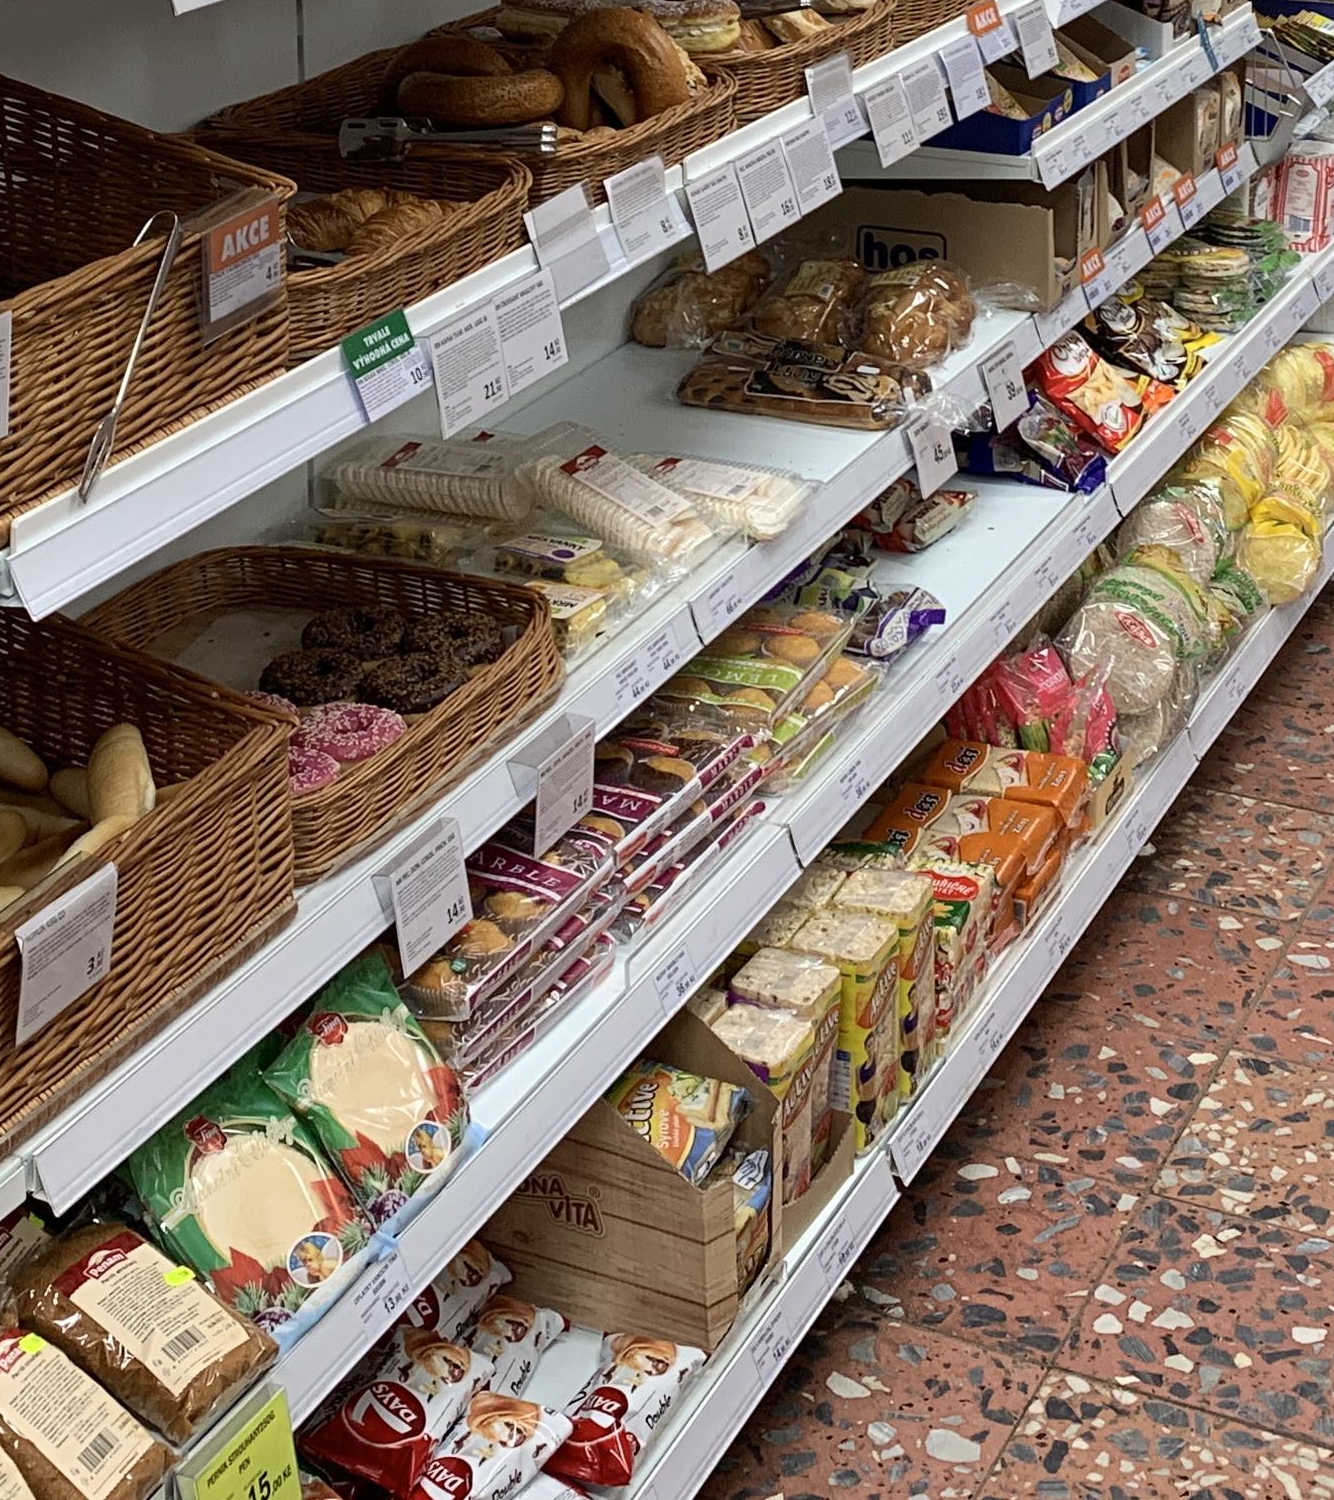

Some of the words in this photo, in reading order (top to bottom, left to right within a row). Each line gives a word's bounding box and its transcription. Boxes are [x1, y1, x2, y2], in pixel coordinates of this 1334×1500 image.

[974, 10, 999, 30] AKCE
[221, 214, 270, 261] AKCE
[353, 341, 392, 371] VÝHODNÁ
[390, 332, 411, 350] CENA
[363, 325, 391, 348] TRVALE
[544, 341, 556, 360] 14
[411, 367, 423, 384] 10
[484, 381, 496, 400] 21
[469, 849, 562, 888] ARBLE
[446, 902, 459, 925] 14
[626, 1081, 659, 1144] ctive
[546, 1199, 599, 1232] VITA
[87, 1251, 126, 1279] Penam
[353, 1388, 413, 1437] 7
[372, 1382, 419, 1425] DAYS
[645, 1393, 672, 1430] Double
[427, 1459, 465, 1491] DAYS
